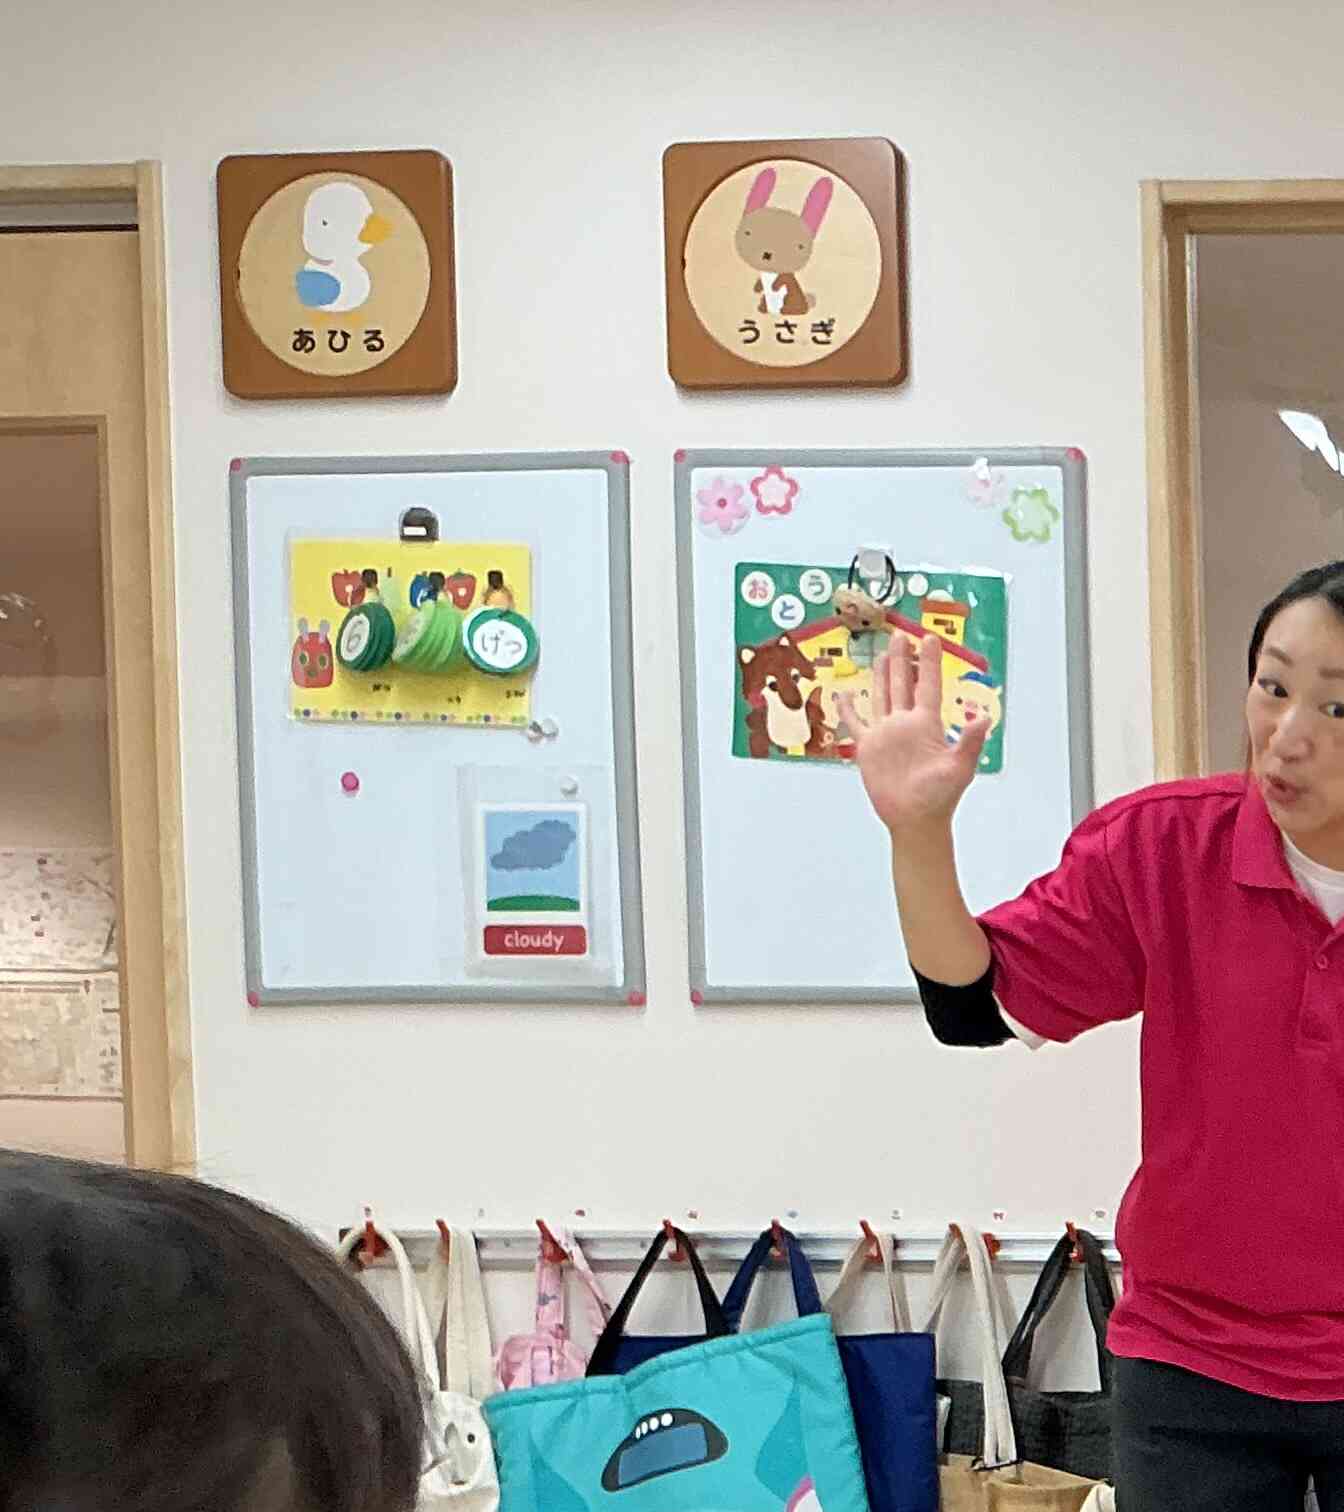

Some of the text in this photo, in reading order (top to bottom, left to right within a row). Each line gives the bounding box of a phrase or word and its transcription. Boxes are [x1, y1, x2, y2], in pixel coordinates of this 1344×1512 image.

[292, 327, 385, 354] あひる
[738, 318, 836, 345] うさぎ
[504, 930, 565, 953] cloudy
